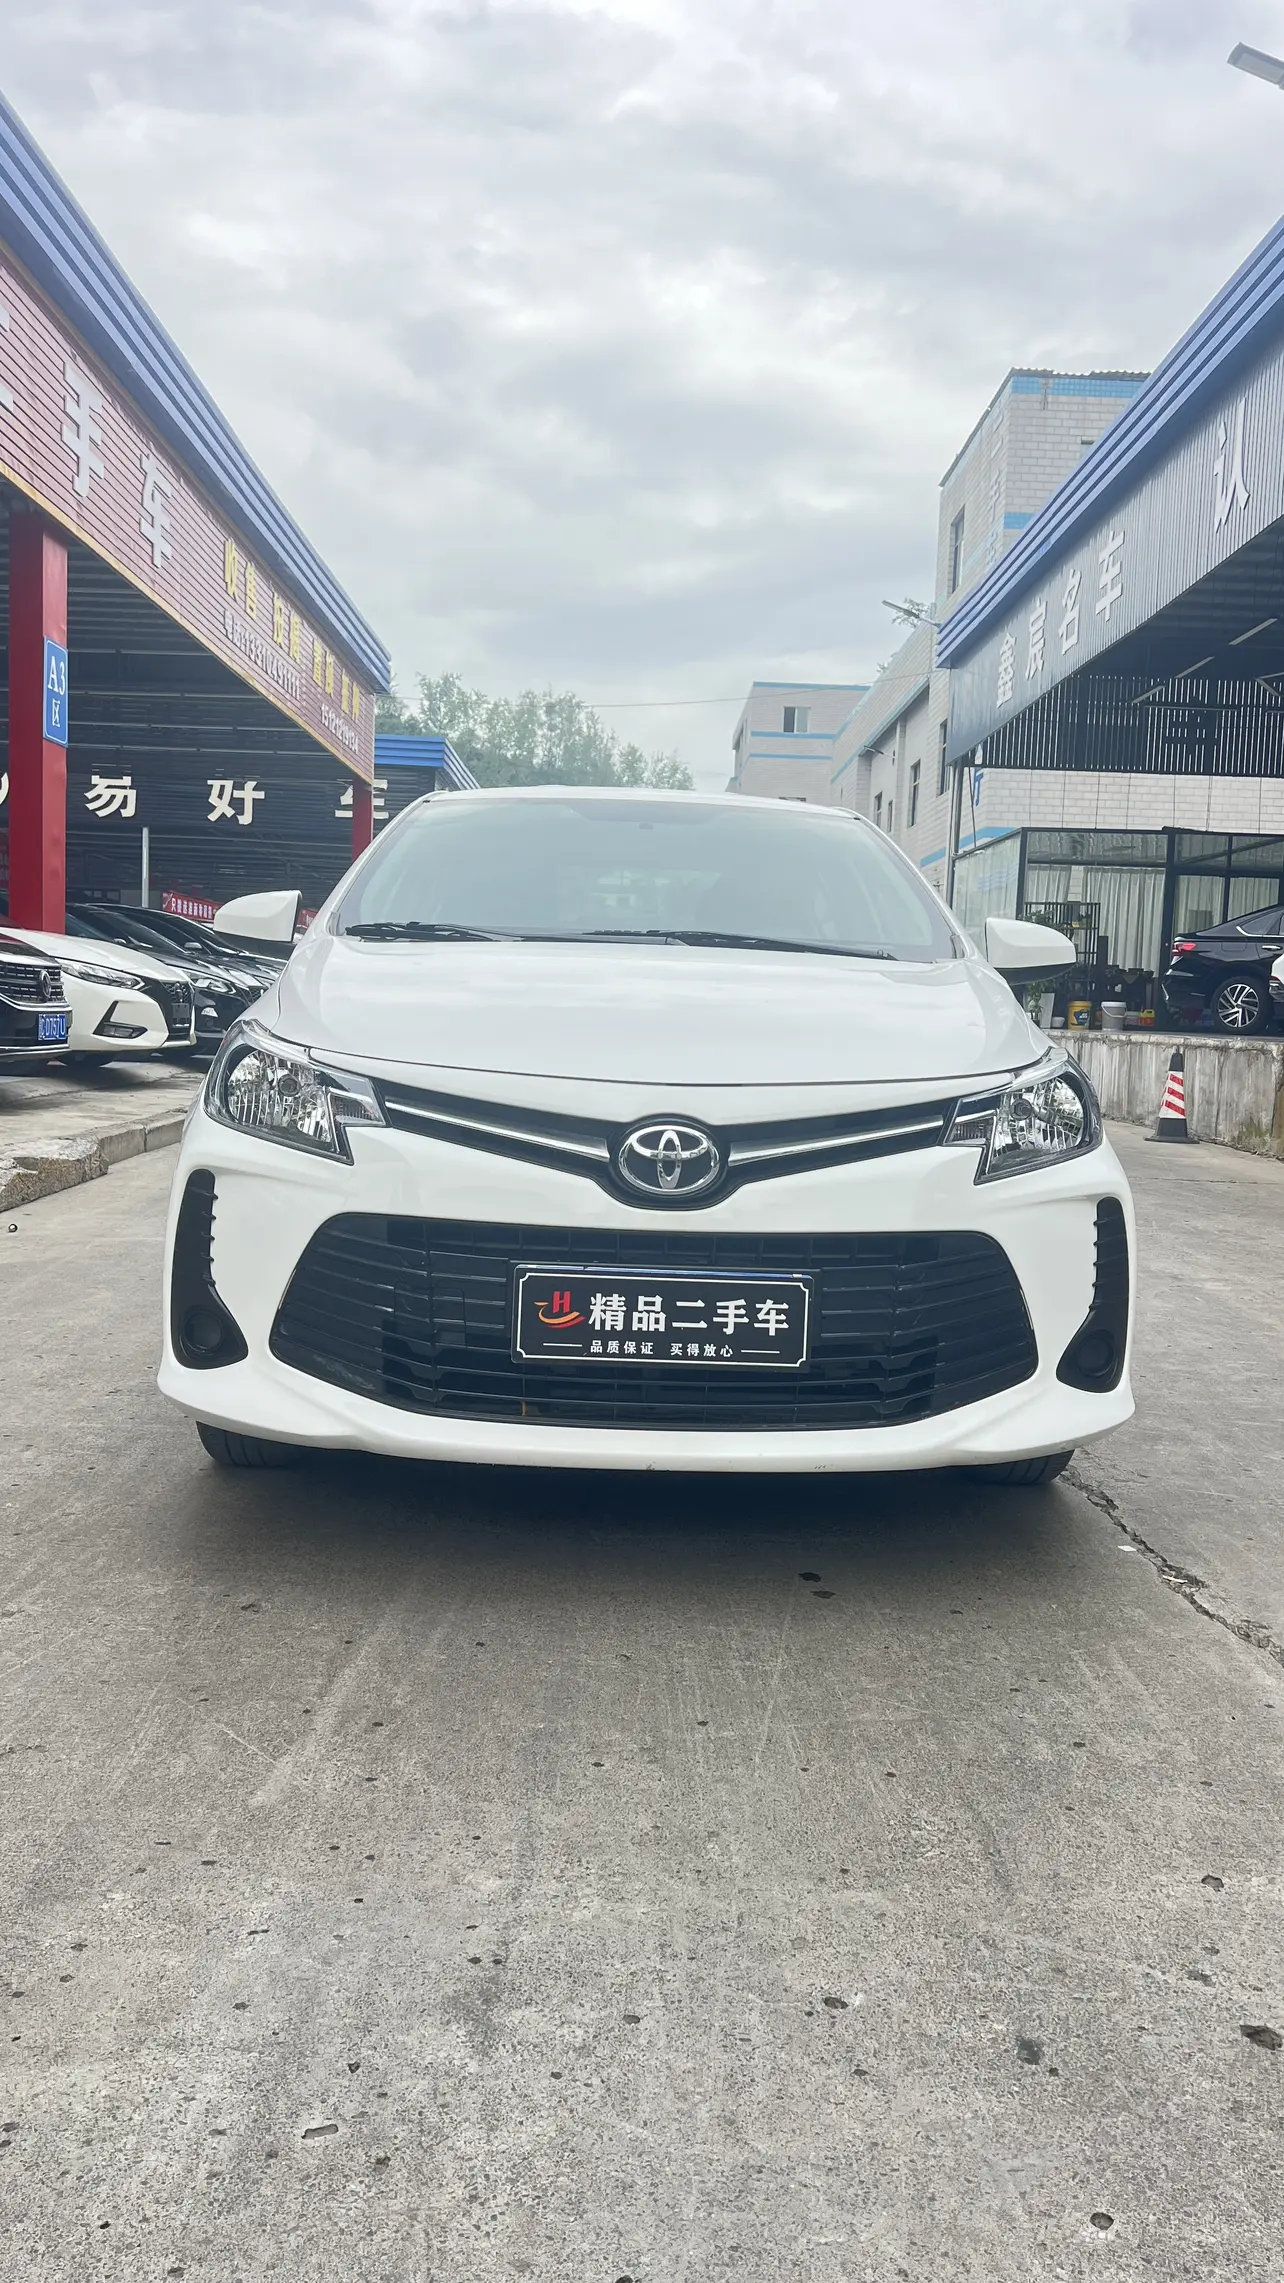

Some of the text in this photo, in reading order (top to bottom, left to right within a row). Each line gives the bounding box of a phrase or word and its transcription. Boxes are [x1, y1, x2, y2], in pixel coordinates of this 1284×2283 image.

[1214, 397, 1250, 534] 认
[47, 656, 66, 695] A3
[52, 698, 60, 727] 区
[0, 772, 389, 826] 易好车
[588, 1292, 790, 1337] 精品二手车
[590, 1339, 734, 1358] 品质保证 买得放心
